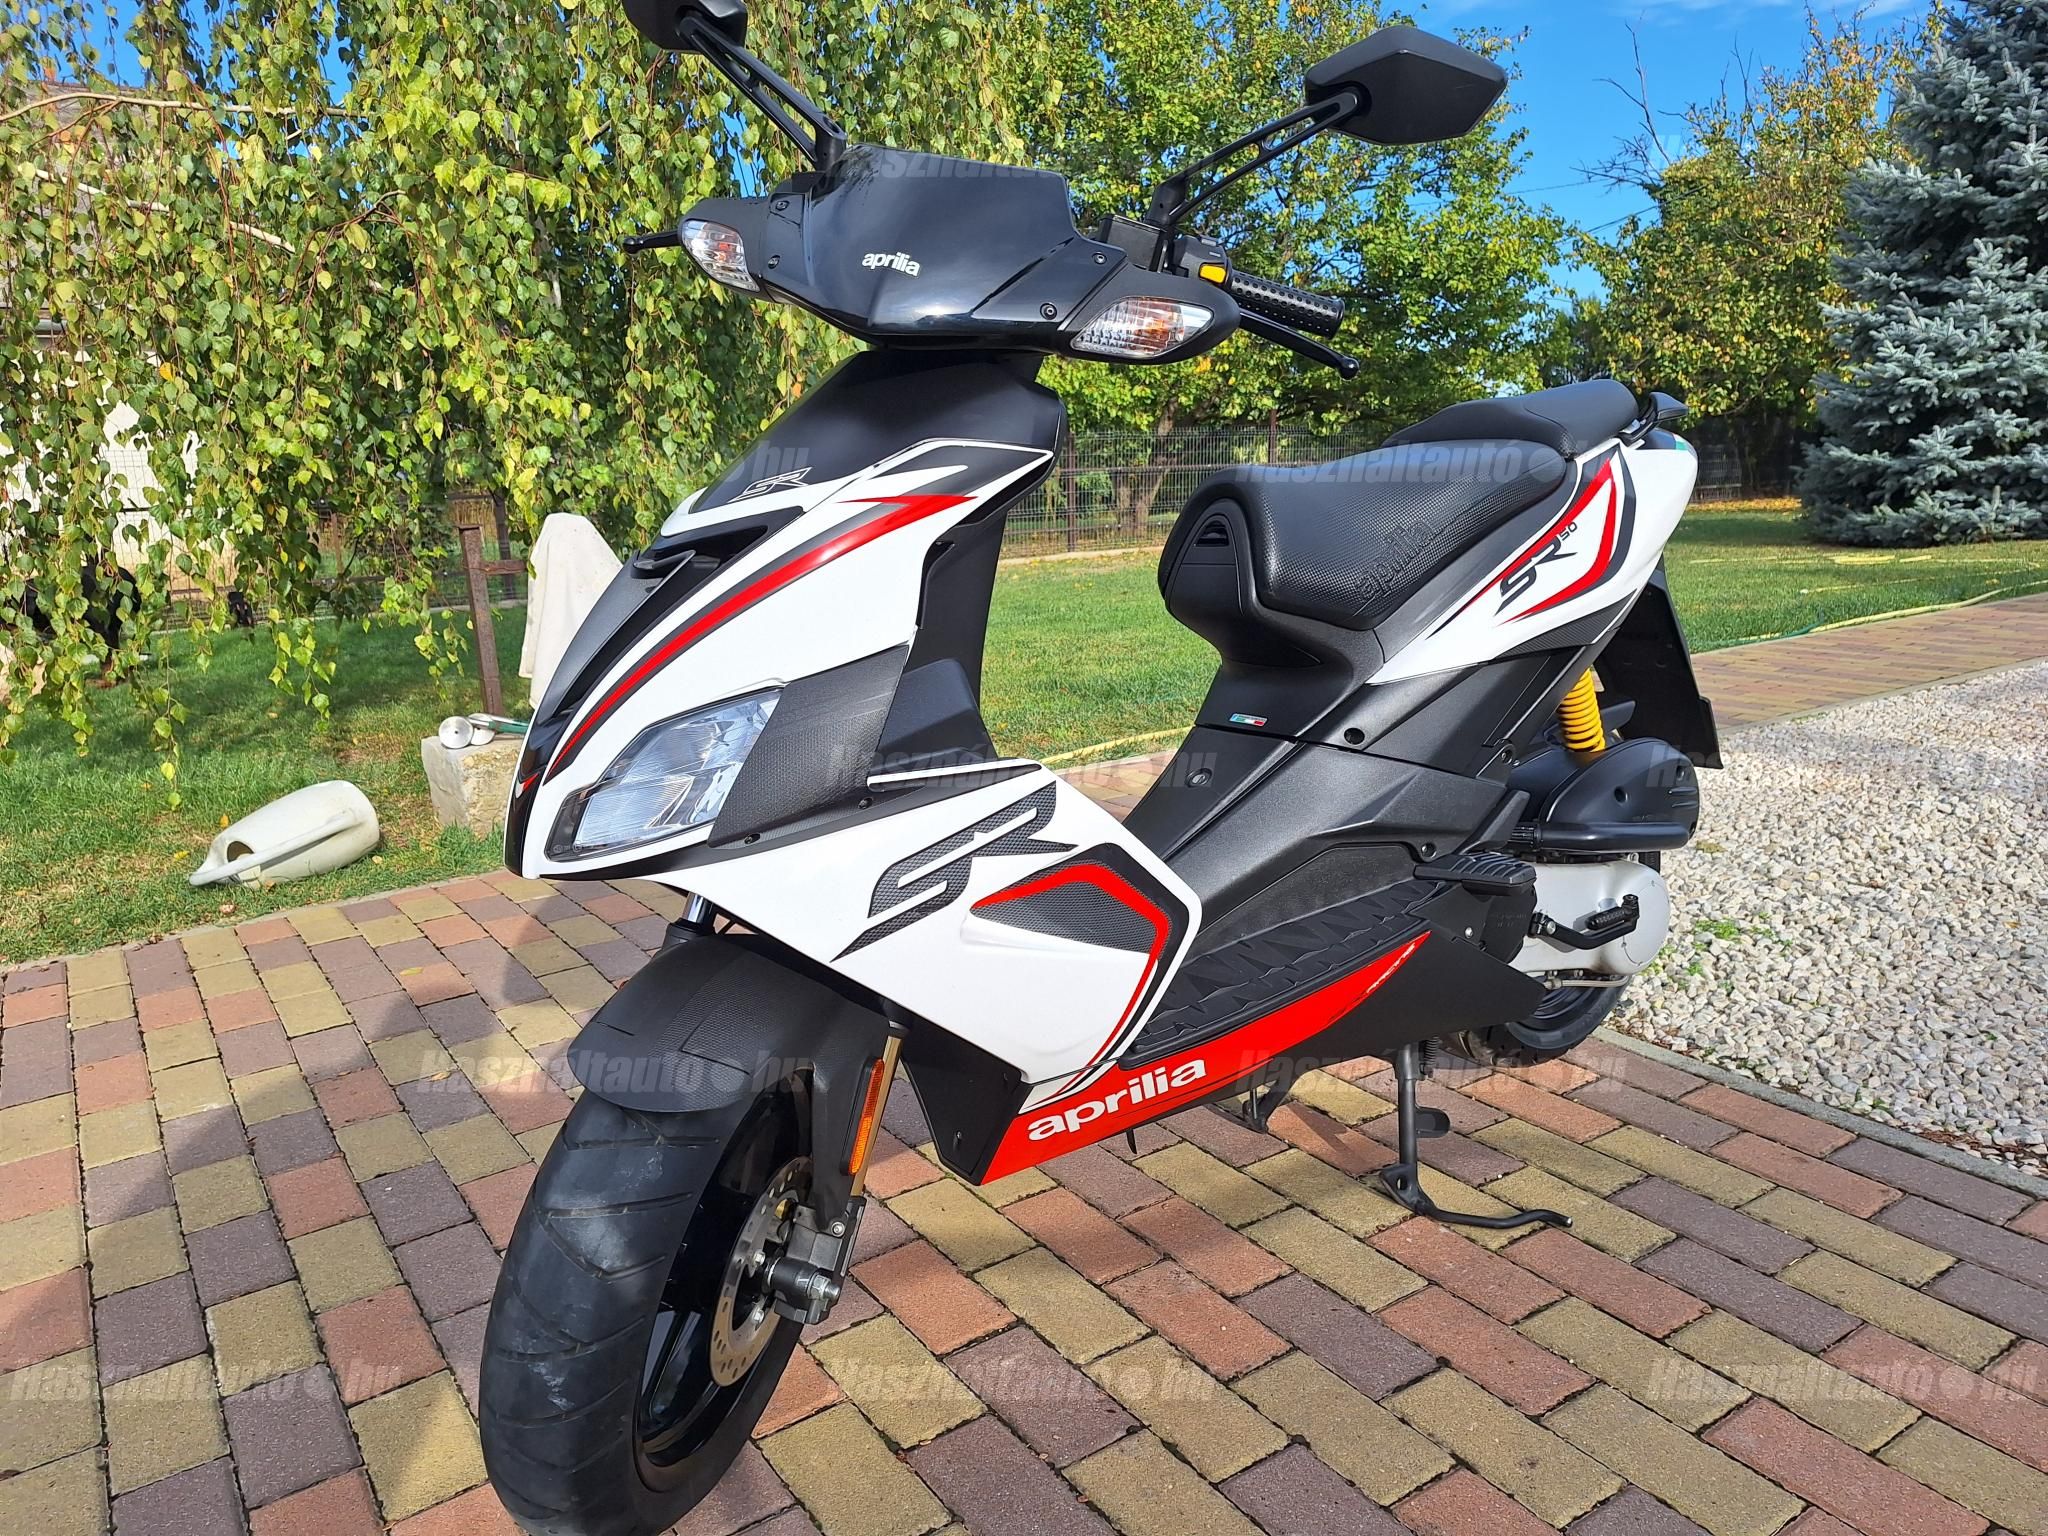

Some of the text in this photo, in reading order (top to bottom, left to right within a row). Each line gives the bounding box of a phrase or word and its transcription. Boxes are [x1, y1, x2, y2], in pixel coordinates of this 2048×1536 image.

[862, 252, 921, 277] aprilia
[727, 467, 813, 503] SR
[1494, 521, 1578, 617] SR 50
[830, 780, 1079, 963] SR
[1027, 1059, 1207, 1141] aprilia
